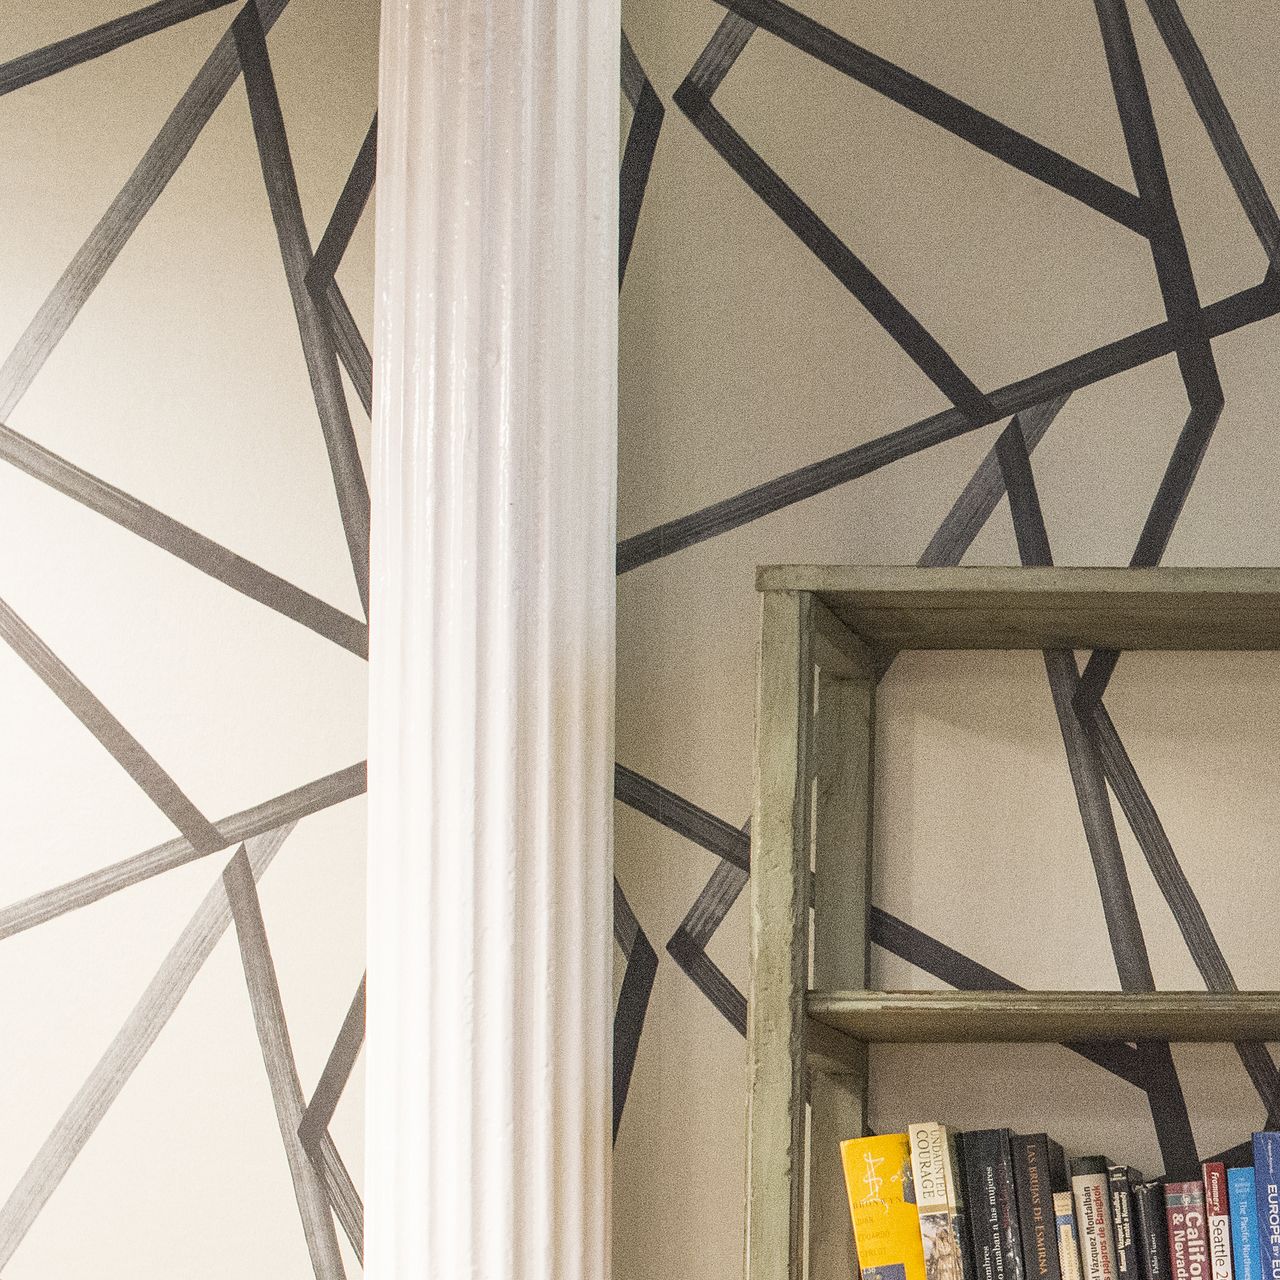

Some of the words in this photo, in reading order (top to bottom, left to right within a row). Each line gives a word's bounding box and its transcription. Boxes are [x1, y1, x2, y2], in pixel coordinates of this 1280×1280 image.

[915, 1128, 935, 1199] COURAGE
[929, 1128, 947, 1198] UNDAUNTED
[1026, 1144, 1037, 1163] LAS
[983, 1164, 998, 1205] mujeres
[1027, 1166, 1041, 1204] BRUJAS
[1090, 1183, 1105, 1224] Bangkok
[988, 1206, 997, 1221] las
[1032, 1207, 1042, 1222] DE
[1080, 1184, 1095, 1234] Montalbán
[1171, 1211, 1184, 1225] &
[1239, 1201, 1248, 1214] The
[1266, 1183, 1280, 1244] EUROPE
[1096, 1226, 1106, 1238] de
[1211, 1218, 1228, 1266] Seattle
[1239, 1216, 1249, 1242] Pacific
[990, 1231, 1003, 1271] amaban
[1033, 1224, 1050, 1275] ESMIRNA
[1087, 1235, 1100, 1273] Vázquez
[1097, 1239, 1110, 1273] pájaros
[1272, 1245, 1279, 1257] BY
